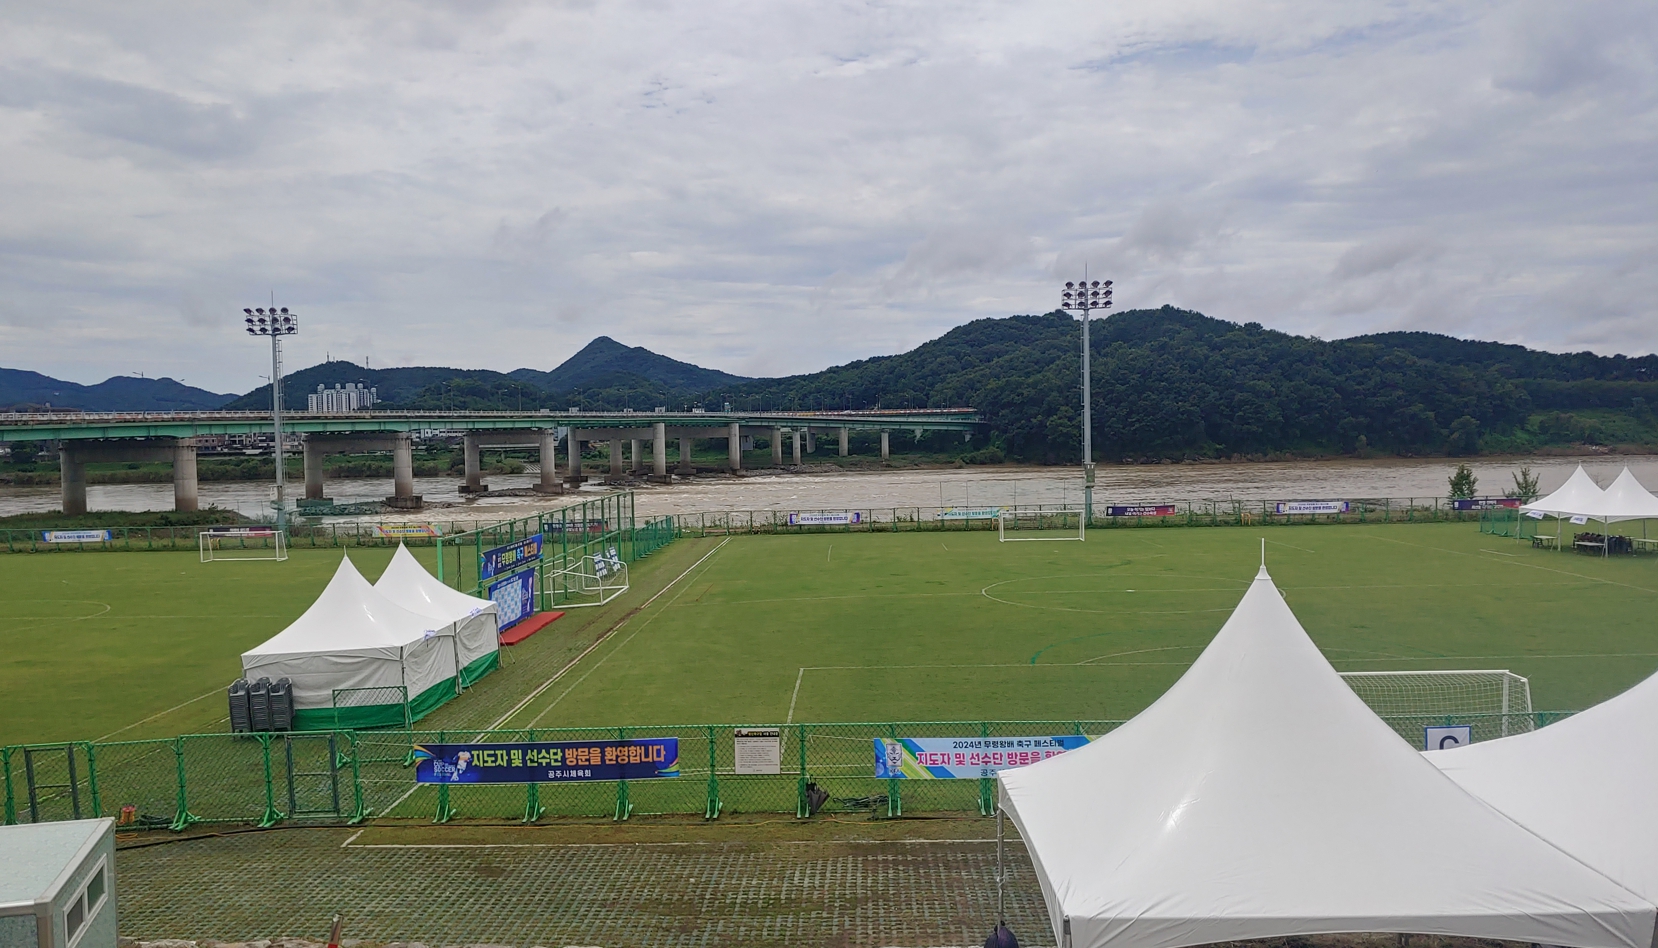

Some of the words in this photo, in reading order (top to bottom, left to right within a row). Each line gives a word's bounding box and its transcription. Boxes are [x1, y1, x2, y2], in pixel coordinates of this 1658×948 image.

[953, 741, 982, 749] 2024년
[984, 740, 1015, 749] 무령왕배
[1017, 740, 1032, 748] 축구
[1034, 739, 1065, 748] 페스티벌
[471, 749, 509, 767] 지도자
[511, 749, 523, 767] 및
[525, 748, 563, 767] 선수단
[565, 747, 602, 766] 방문을
[604, 744, 666, 765] 환영합니다
[917, 752, 951, 766] 지도자
[954, 752, 966, 766] 및
[969, 752, 1004, 766] 선수단
[1007, 751, 1041, 766] 방문을
[547, 769, 592, 779] 공주시체육회
